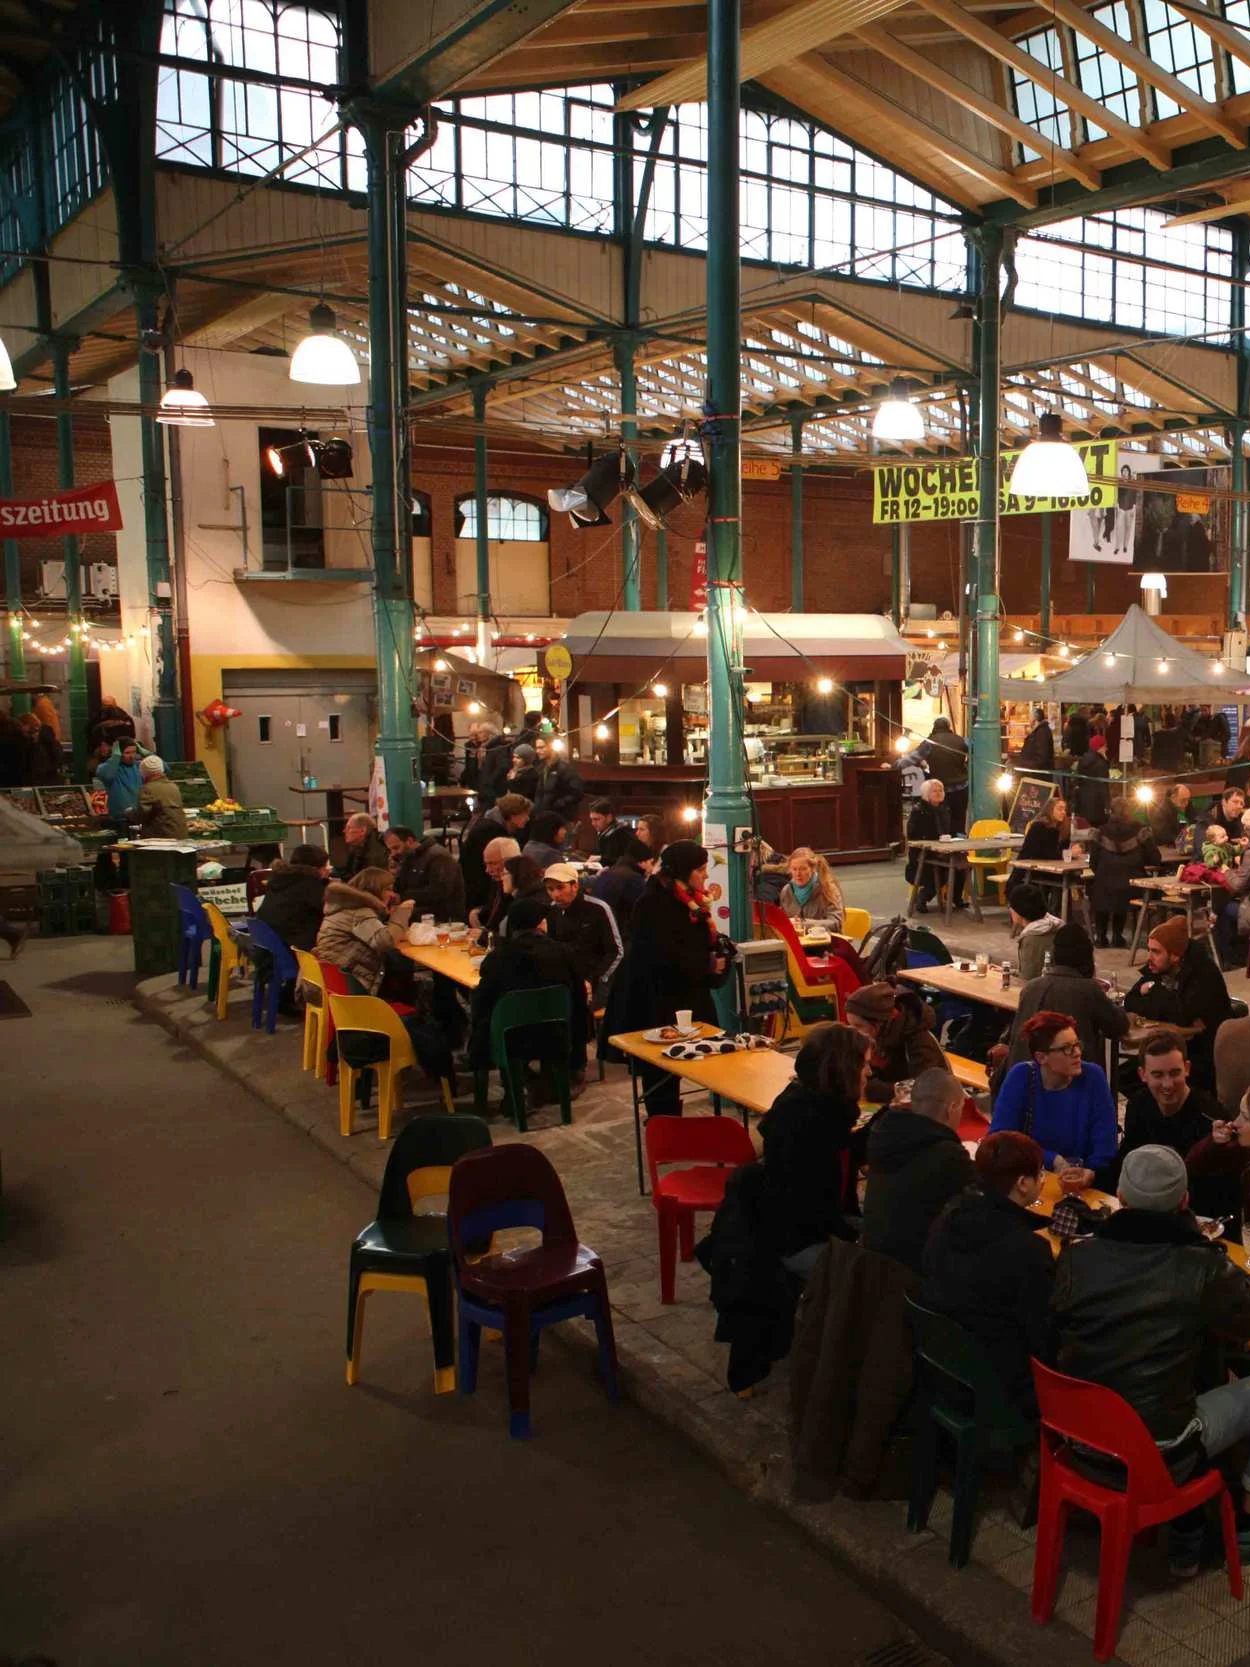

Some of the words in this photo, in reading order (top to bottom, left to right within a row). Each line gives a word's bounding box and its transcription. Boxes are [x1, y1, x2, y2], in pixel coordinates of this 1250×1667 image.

[0, 499, 110, 526] szeitung
[880, 499, 900, 521] FR
[999, 490, 1020, 512] SA
